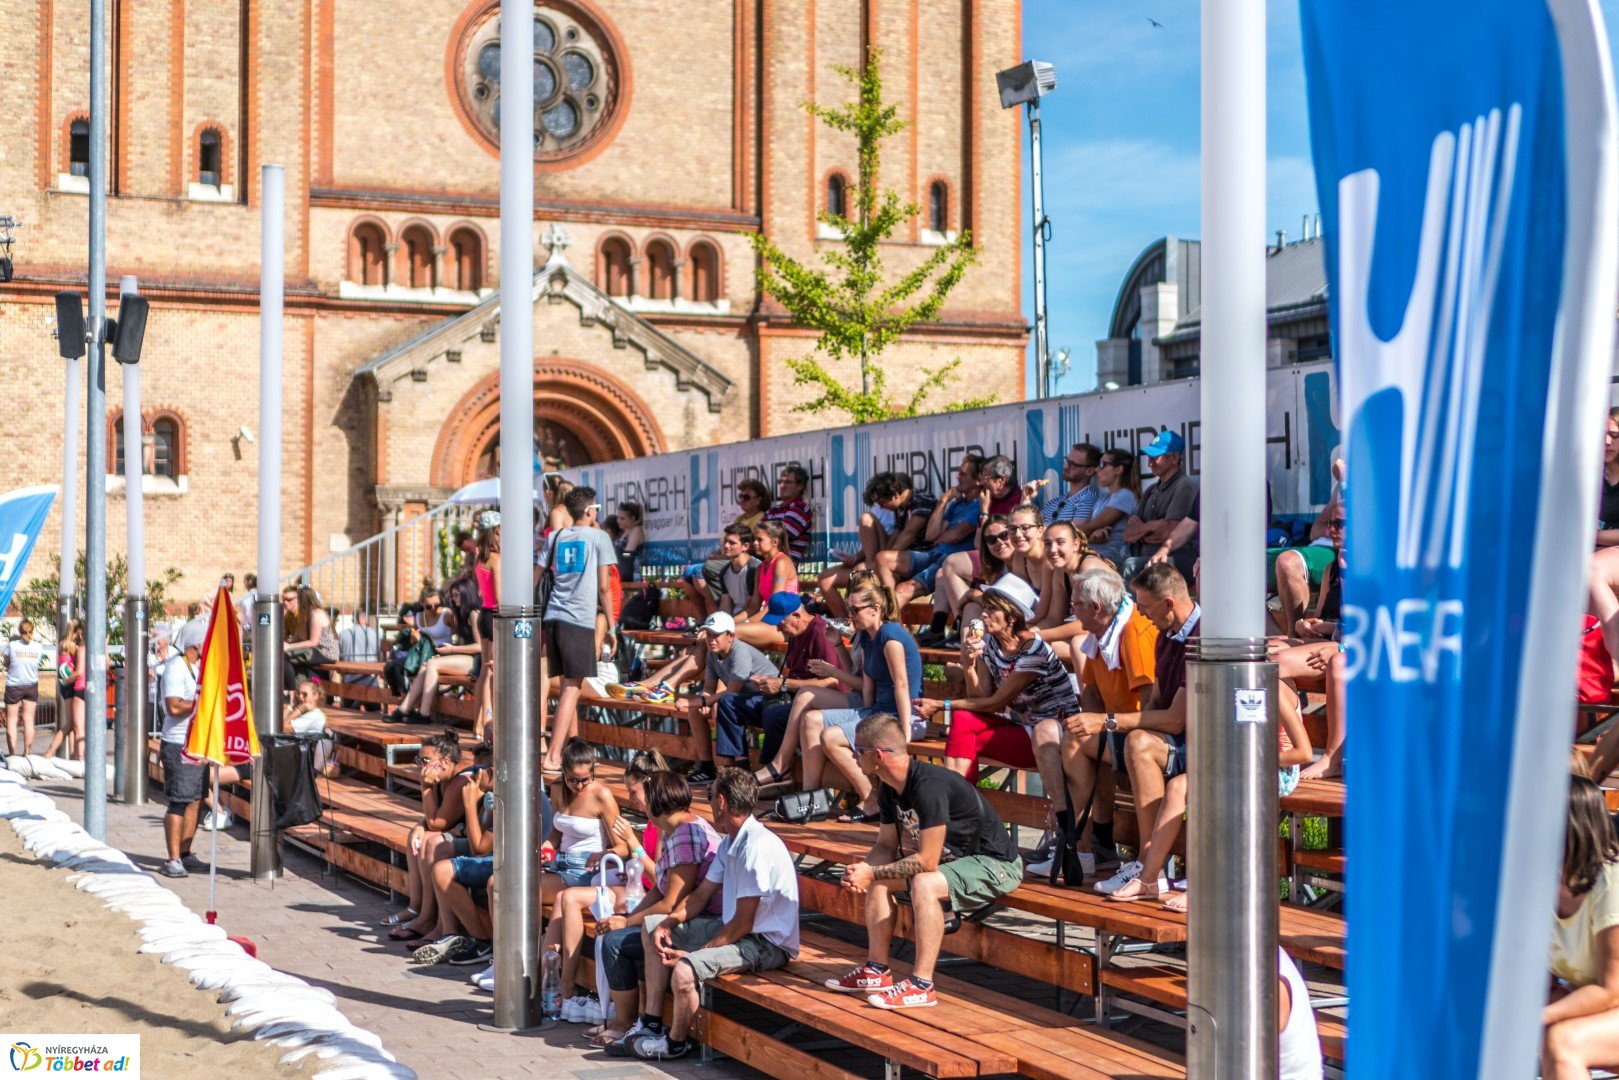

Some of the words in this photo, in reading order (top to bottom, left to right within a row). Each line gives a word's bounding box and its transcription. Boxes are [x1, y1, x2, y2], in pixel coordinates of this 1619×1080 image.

[1340, 599, 1464, 684] BNER
[856, 977, 882, 988] retro
[903, 992, 927, 1005] retro
